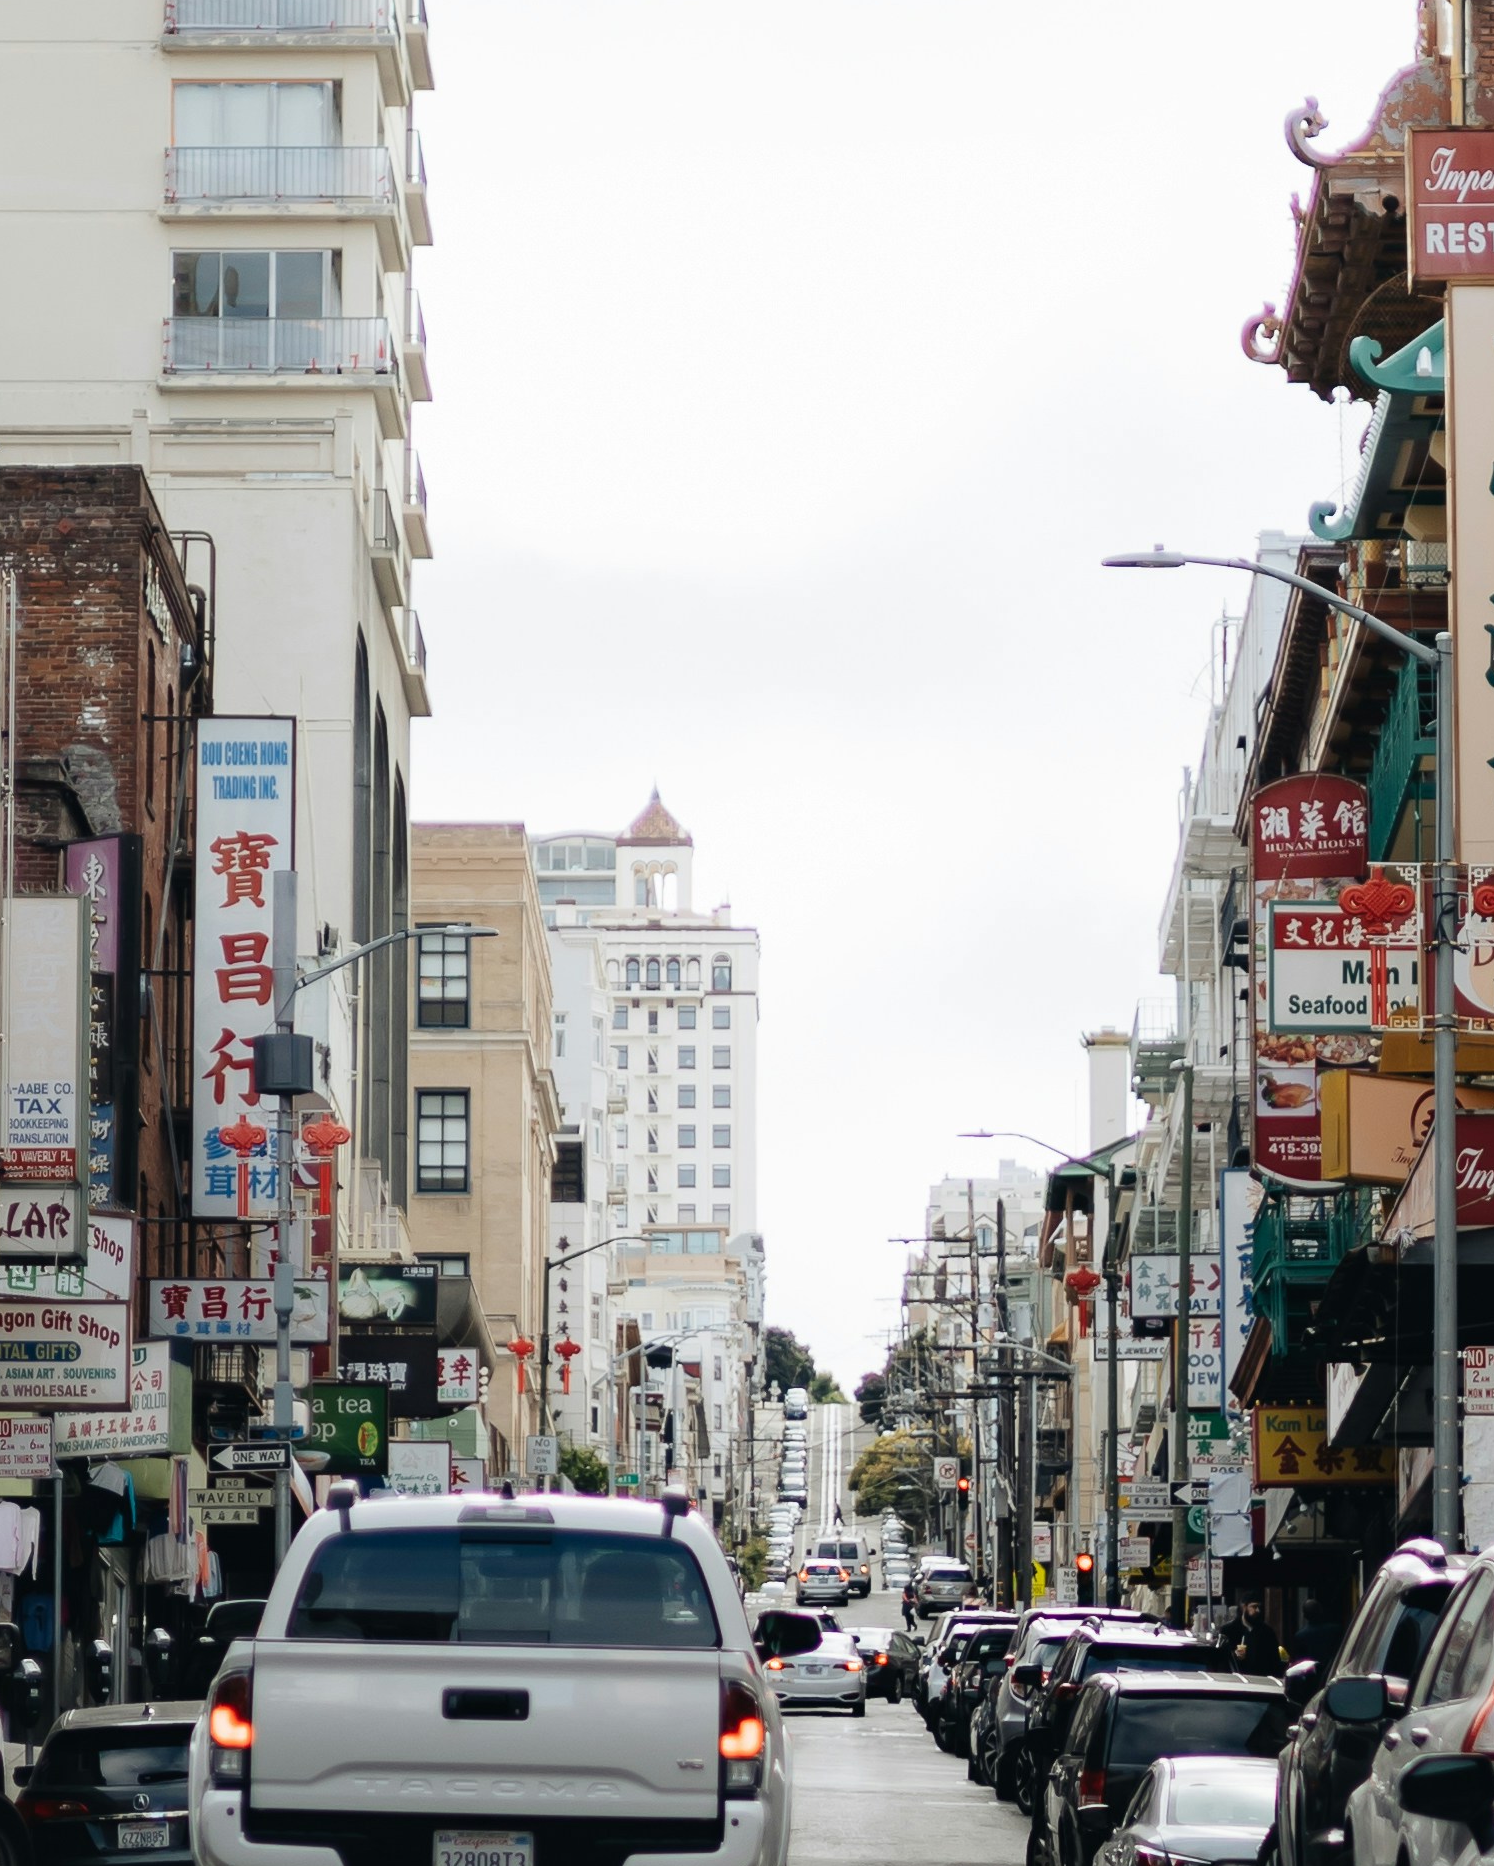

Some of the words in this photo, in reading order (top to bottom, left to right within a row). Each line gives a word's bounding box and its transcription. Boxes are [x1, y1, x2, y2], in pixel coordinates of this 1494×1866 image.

[201, 741, 223, 766] BOU
[224, 741, 258, 766] COENG
[260, 741, 288, 766] HONG
[212, 775, 257, 800] TRADING
[258, 775, 279, 800] INC.
[1265, 842, 1314, 853] HUNAN
[1318, 838, 1364, 849] HOUSE
[1288, 994, 1368, 1015] Seafood
[14, 1098, 62, 1115] TAX
[8, 1132, 69, 1144] TRANSLATION
[21, 1150, 57, 1163] WAVERLY
[94, 1225, 125, 1265] Shop
[160, 1283, 272, 1321] 寶昌行
[41, 1308, 73, 1332] Gift
[78, 1314, 120, 1349] Shop
[35, 1343, 78, 1360] GIFTS
[1467, 1349, 1485, 1367] NO
[5, 1368, 34, 1380] ASIAN
[36, 1367, 56, 1380] ART
[63, 1367, 117, 1380] SOUVENIRS
[0, 1385, 9, 1396] &
[13, 1384, 88, 1397] WHOLESALE
[1468, 1387, 1483, 1399] MON
[337, 1395, 373, 1414] tea
[13, 1422, 49, 1435] PARKING
[1265, 1414, 1301, 1433] Kam
[72, 1439, 94, 1452] SHUN
[94, 1437, 111, 1449] ARTS
[120, 1432, 169, 1447] HANDICRAFTS
[535, 1439, 550, 1448] NO
[14, 1454, 34, 1465] THURS
[37, 1454, 49, 1464] SUN
[232, 1451, 255, 1463] ONE
[258, 1450, 282, 1462] WAY
[359, 1458, 376, 1466] TEA
[221, 1479, 239, 1487] END
[196, 1492, 264, 1503] WAVERLY
[353, 1777, 623, 1800] TACOMA
